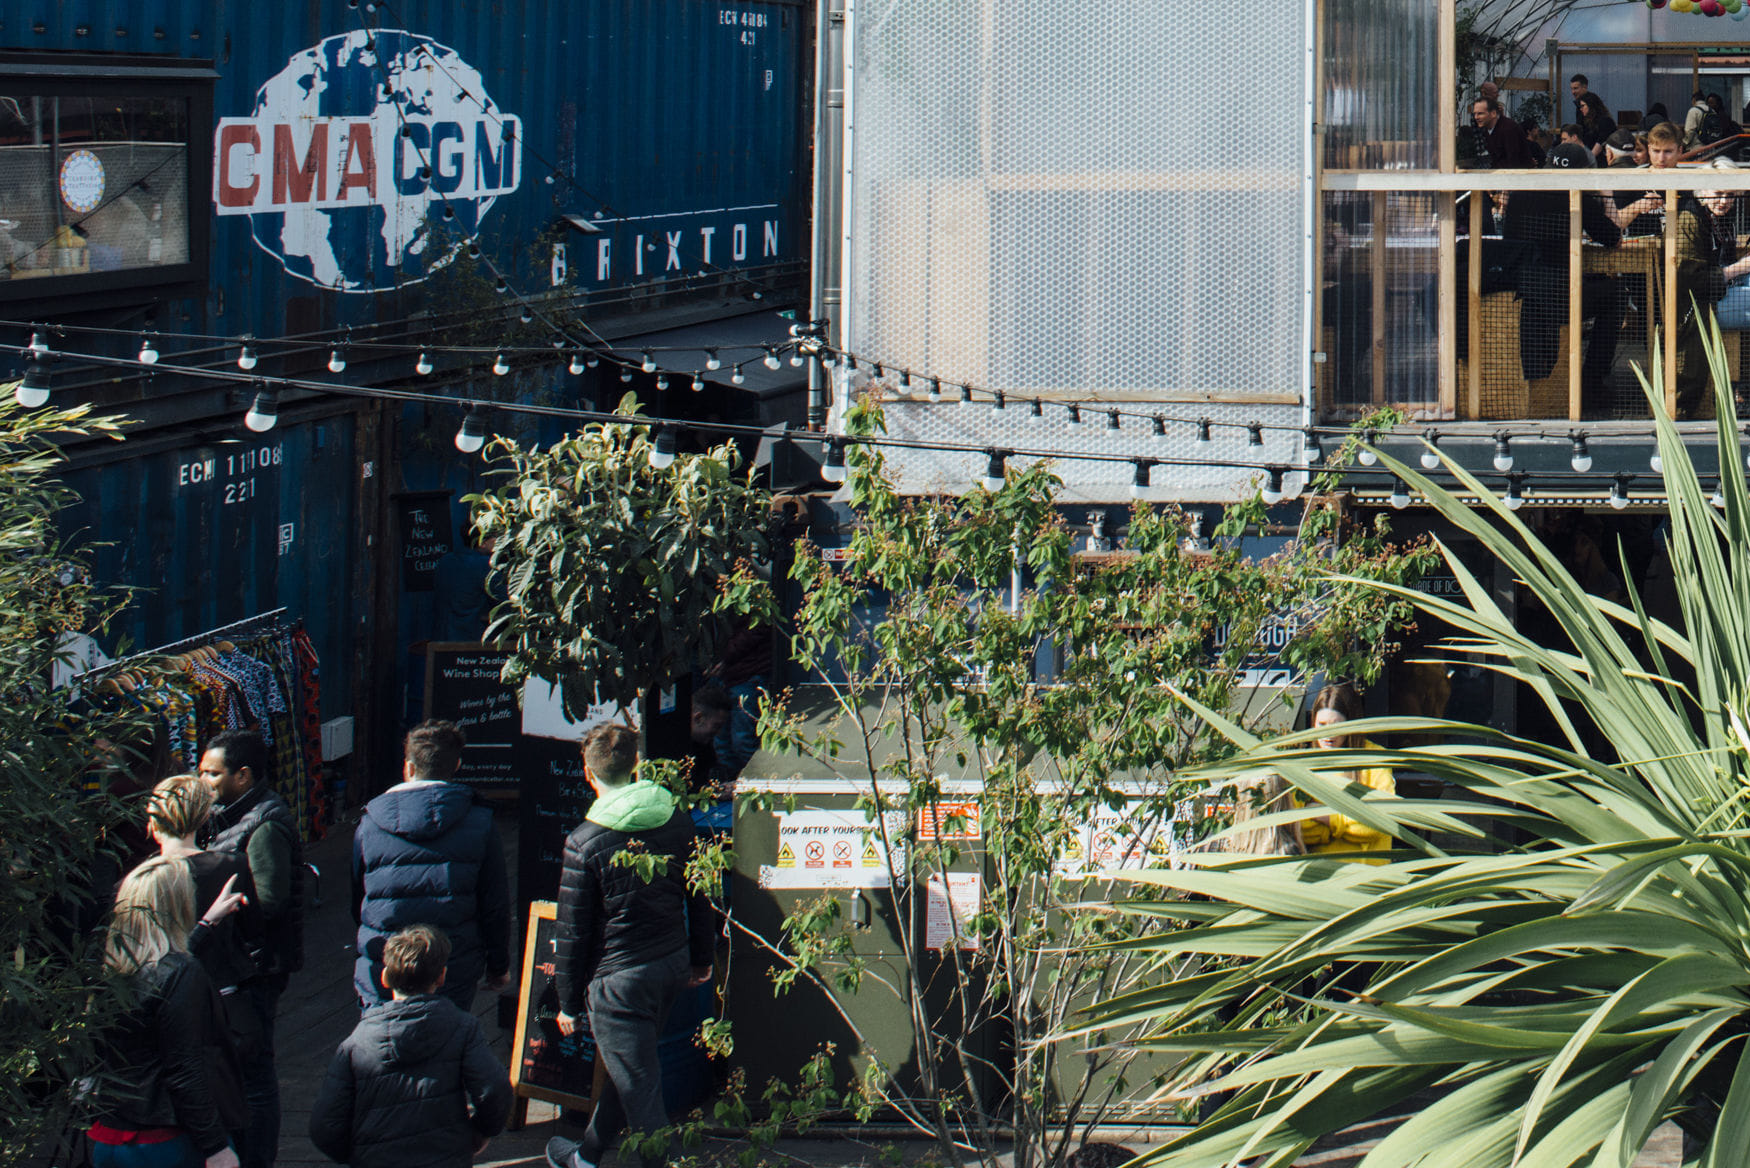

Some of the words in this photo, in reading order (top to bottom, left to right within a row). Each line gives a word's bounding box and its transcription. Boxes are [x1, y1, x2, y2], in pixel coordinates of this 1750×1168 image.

[219, 122, 378, 207] CMA
[393, 118, 517, 196] CGM
[551, 219, 779, 287] BRIXTON
[479, 656, 510, 665] Zeala
[443, 669, 473, 679] Wine
[781, 826, 799, 835] OOK
[801, 825, 830, 835] AFTER
